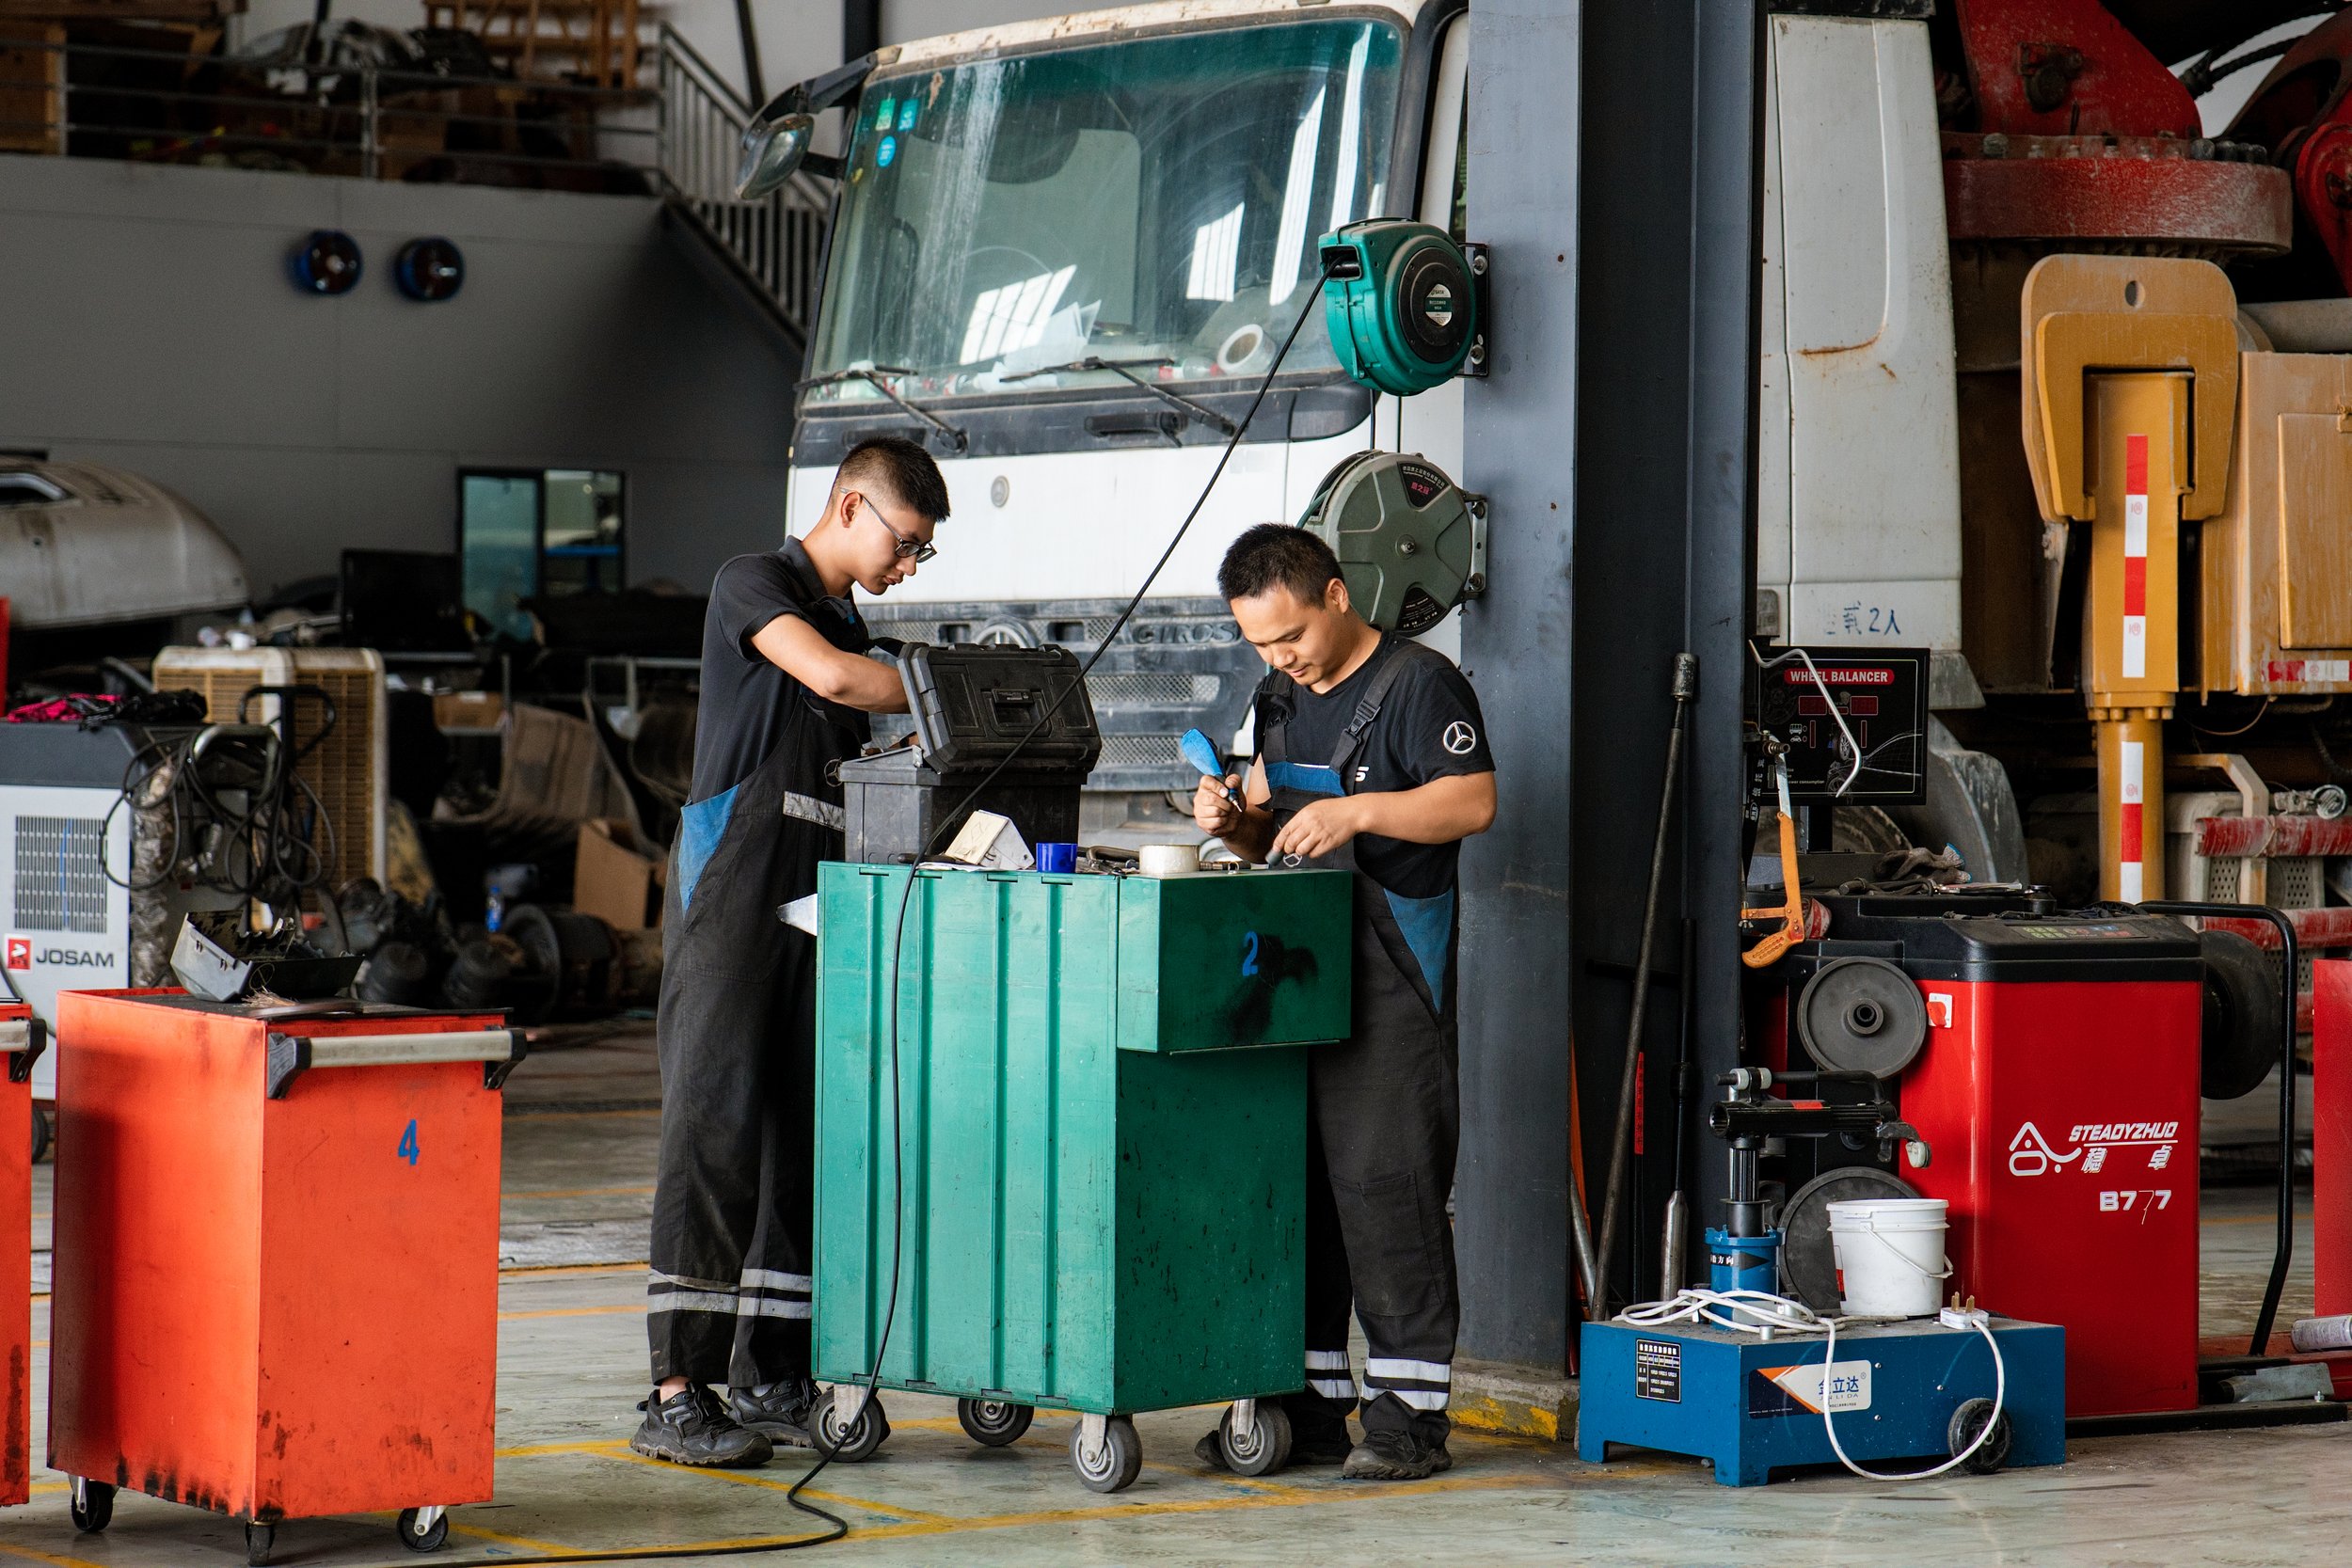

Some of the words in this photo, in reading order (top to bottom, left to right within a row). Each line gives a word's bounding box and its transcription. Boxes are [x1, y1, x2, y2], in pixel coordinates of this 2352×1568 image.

[1831, 671, 1888, 683] BALANCER
[36, 948, 114, 967] JOSAM
[1243, 930, 1259, 976] 2
[398, 1119, 420, 1165] 4
[2069, 1122, 2179, 1142] STEADYZHUO
